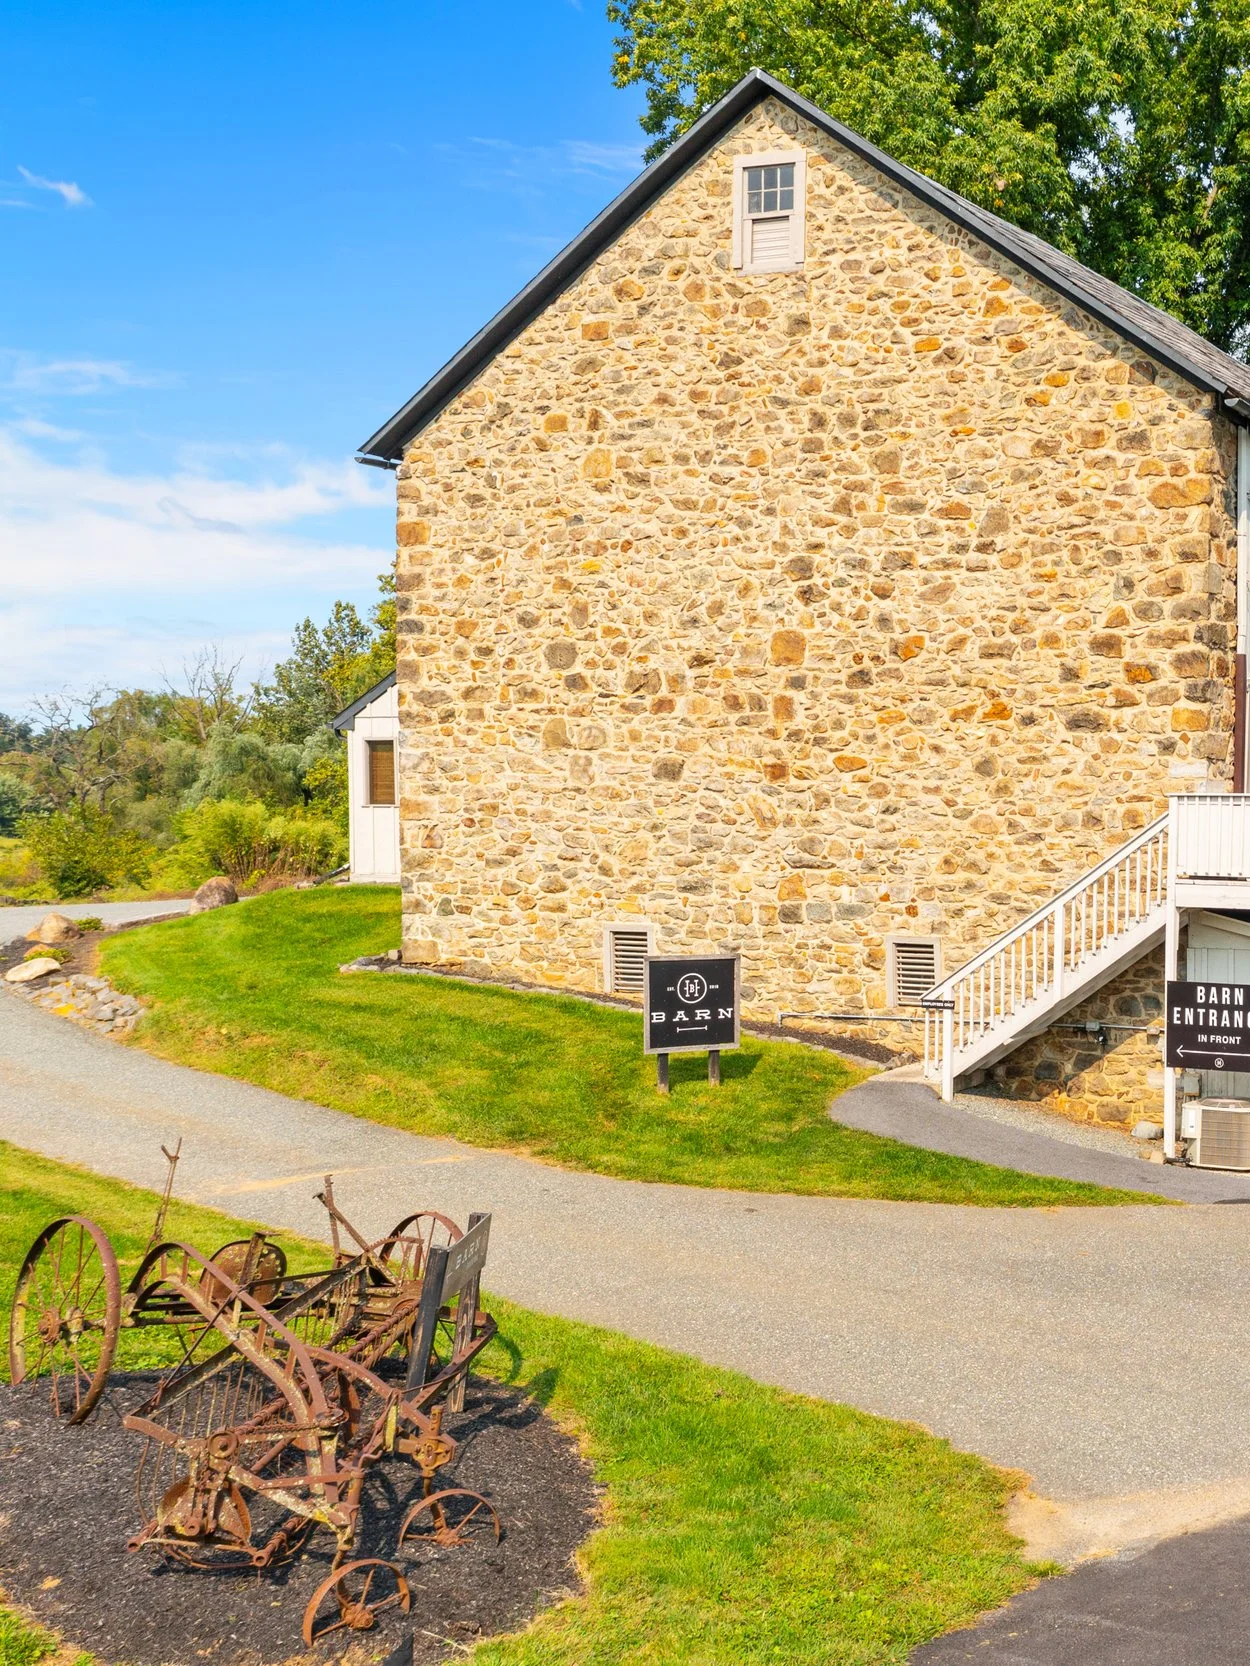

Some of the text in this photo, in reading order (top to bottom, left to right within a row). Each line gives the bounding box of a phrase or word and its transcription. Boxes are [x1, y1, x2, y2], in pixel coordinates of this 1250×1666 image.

[1197, 986, 1244, 1006] BARN
[651, 1008, 733, 1023] BARN
[1197, 1034, 1241, 1044] IN FRONT
